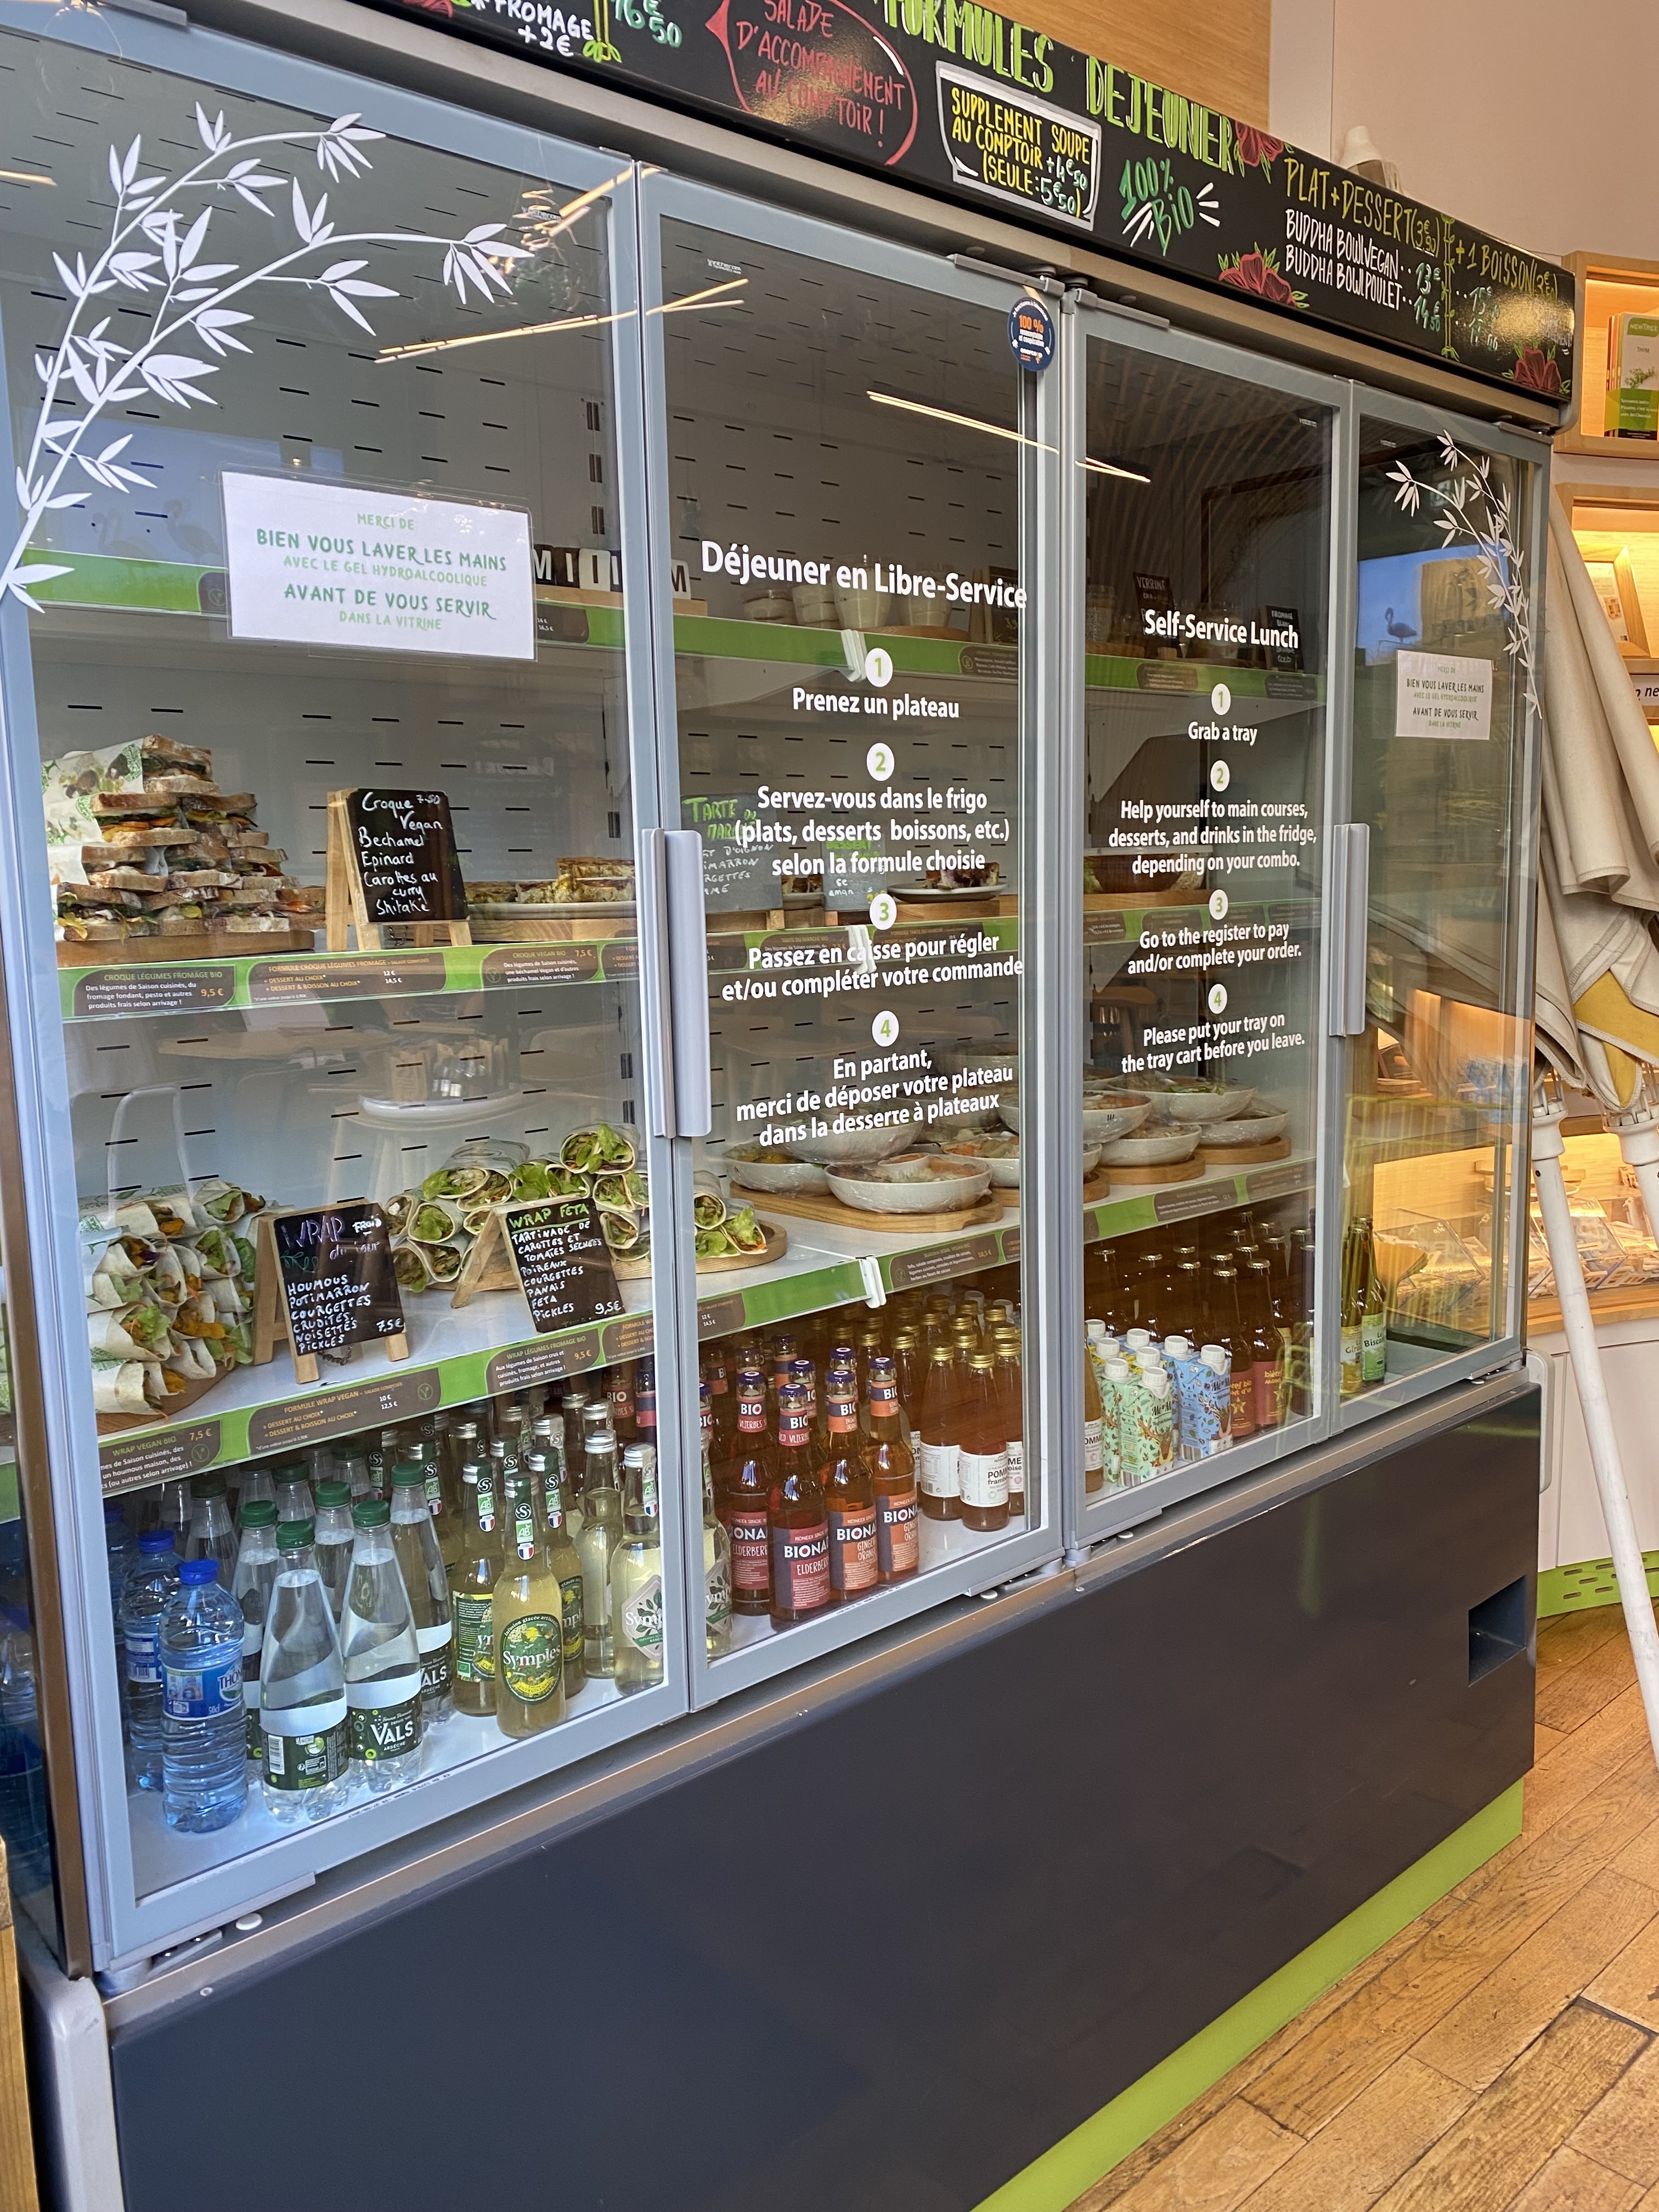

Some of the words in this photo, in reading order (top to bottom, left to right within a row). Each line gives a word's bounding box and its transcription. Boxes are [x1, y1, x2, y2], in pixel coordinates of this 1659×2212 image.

[884, 0, 1054, 92] FORMULES
[951, 87, 1042, 145] SUPPLEMENT
[1051, 124, 1090, 165] SOUPE
[952, 116, 972, 143] AU
[1285, 208, 1333, 255] BUDDHA
[1285, 244, 1333, 286] BUDDHA
[1365, 271, 1403, 311] POULET
[357, 512, 394, 529] MERCI
[399, 518, 414, 531] DE
[256, 528, 300, 549] BIEN
[307, 534, 354, 555] VOUS
[362, 540, 424, 565] LAVER
[424, 549, 452, 565] LES
[459, 552, 507, 571] MAINS
[283, 555, 319, 570] AVEC
[323, 559, 338, 571] LE
[343, 561, 367, 575] GEL
[373, 565, 488, 586] HYDROALCOOLIQUE
[702, 540, 831, 585] Déjeuner
[836, 565, 868, 590] en
[874, 563, 1028, 609] Libre-Service
[284, 583, 345, 604] AVANT
[354, 589, 377, 606] DE
[385, 592, 428, 612] VOUS
[436, 597, 497, 620] SERVIR
[339, 610, 371, 625] DANS
[376, 614, 392, 626] LA
[396, 616, 442, 631] VITRINE
[1144, 608, 1248, 644] Self-Service
[1250, 621, 1299, 650] Lunch
[874, 657, 883, 678] 1
[1407, 678, 1420, 689] BIEN
[1421, 680, 1436, 690] VOUS
[1438, 681, 1457, 693] LAVER
[1457, 684, 1467, 692] LES
[1468, 685, 1485, 693] MAINS
[793, 687, 860, 714] Prenez
[864, 696, 888, 714] un
[892, 693, 960, 721] plateau
[1218, 691, 1224, 708] 1
[1188, 721, 1220, 741] Grab
[1222, 726, 1230, 741] a
[1232, 724, 1257, 747] tray
[875, 752, 886, 772] 2
[1216, 768, 1223, 785] 2
[362, 791, 413, 819] Croque
[757, 785, 877, 810] Servez-vous
[879, 786, 924, 809] dans
[927, 787, 943, 809] le
[945, 787, 988, 815] frigo
[1121, 799, 1153, 824] Help
[1155, 799, 1209, 823] yourself
[1211, 800, 1226, 818] to
[1227, 800, 1259, 817] main
[1260, 802, 1308, 820] courses,
[399, 810, 443, 835] Vegan
[735, 819, 798, 849] (plats,
[802, 819, 882, 843] desserts
[890, 819, 972, 844] boissons,
[974, 818, 1010, 842] etc.)
[358, 825, 425, 848] Bechamel
[1108, 827, 1171, 849] desserts,
[1172, 826, 1198, 847] and
[1200, 826, 1241, 845] drinks
[1242, 826, 1255, 844] in
[1256, 825, 1277, 843] the
[1279, 825, 1317, 845] fridge,
[360, 850, 414, 872] Epinard
[771, 852, 825, 877] selon
[829, 852, 848, 874] la
[851, 850, 924, 874] formule
[926, 849, 986, 871] choisie
[1132, 854, 1205, 878] depending
[1207, 857, 1224, 871] on
[1226, 855, 1255, 874] your
[1257, 850, 1301, 868] combo.
[364, 870, 417, 887] Carottes
[421, 871, 439, 883] au
[392, 886, 428, 904] curry
[879, 902, 889, 922] 3
[748, 947, 813, 970] Passez
[819, 946, 844, 963] en
[847, 939, 901, 963] caisse
[904, 938, 946, 964] pour
[949, 932, 1000, 960] régler
[173, 971, 209, 979] FROMAGE
[721, 977, 777, 1002] et/ou
[781, 970, 879, 1000] compléter
[882, 966, 929, 988] votre
[932, 956, 1023, 983] commande
[201, 989, 216, 997] 9,5
[509, 1207, 551, 1229] WRAP
[560, 1203, 590, 1218] FETA
[579, 1221, 591, 1230] DE
[517, 1237, 563, 1255] CAROTTES
[567, 1233, 580, 1245] ET
[524, 1247, 565, 1262] TOMATES
[287, 1274, 348, 1296] HOUMOUS
[523, 1266, 584, 1288] COURGETTES
[291, 1294, 372, 1321] COURGETTES
[531, 1295, 557, 1309] FETA
[741, 1403, 763, 1415] BIO
[112, 1445, 136, 1457] WRAP
[136, 1440, 162, 1453] VEGAN
[163, 1436, 177, 1444] BIO
